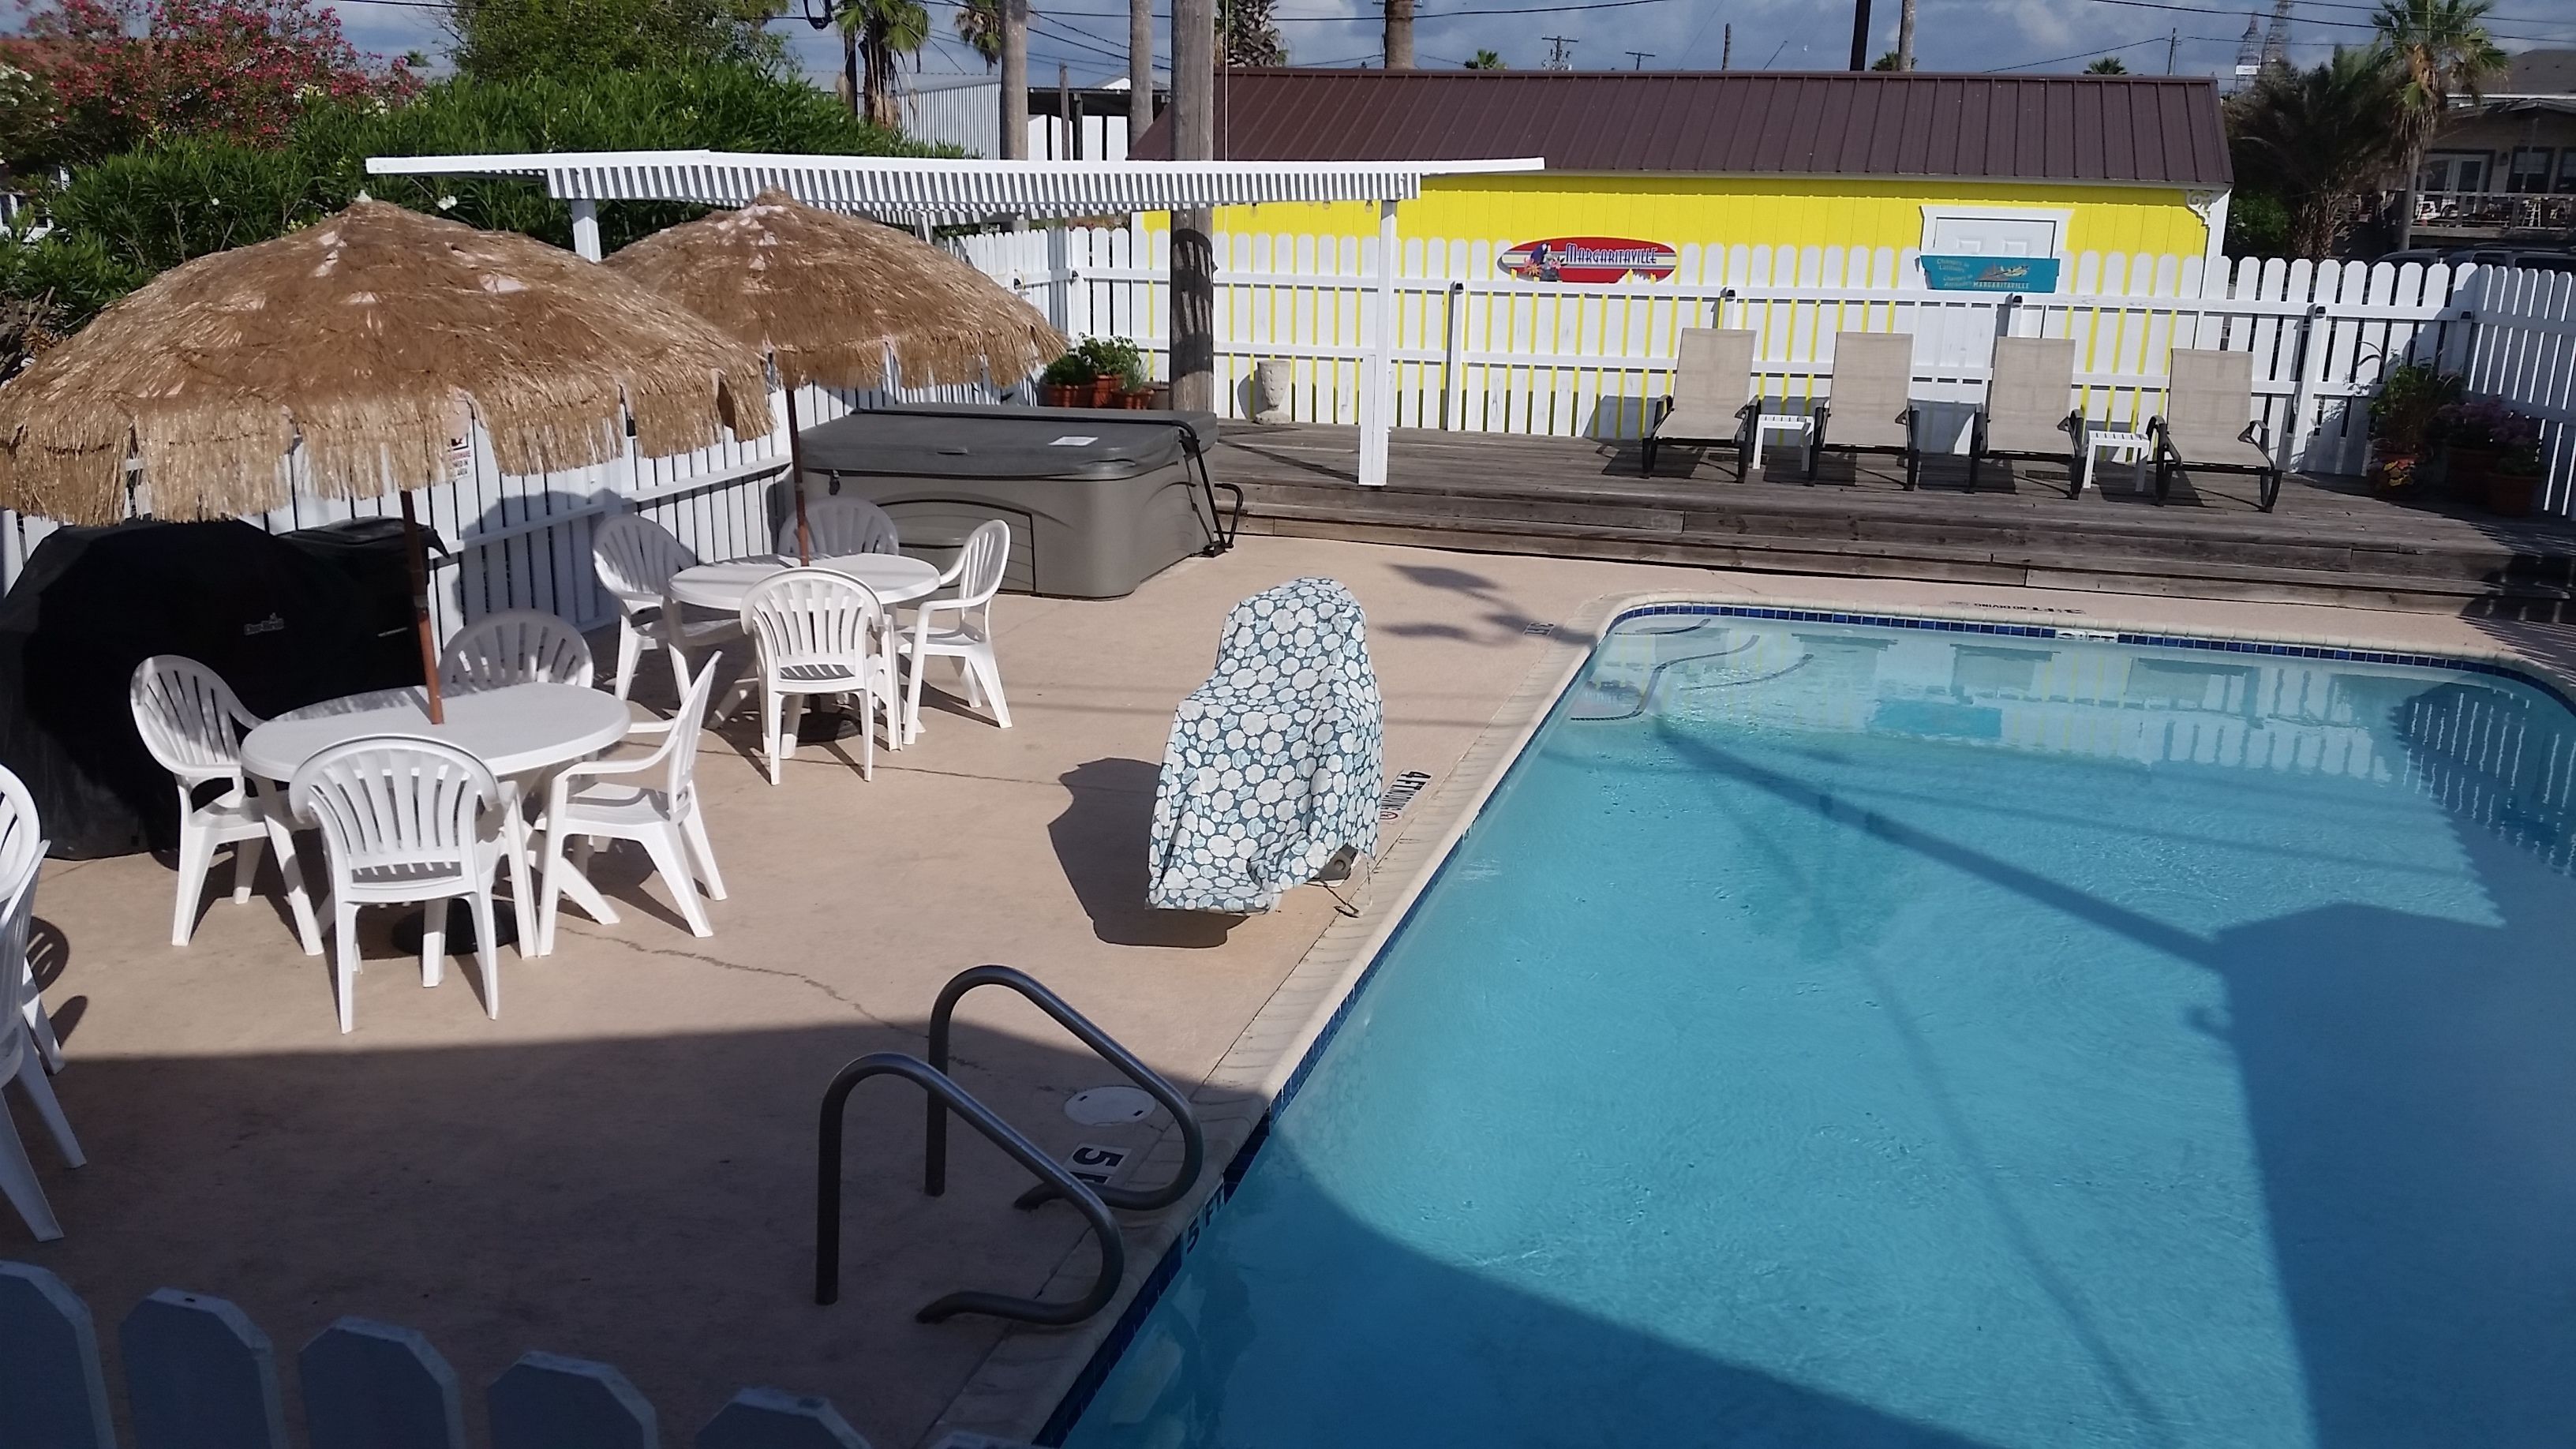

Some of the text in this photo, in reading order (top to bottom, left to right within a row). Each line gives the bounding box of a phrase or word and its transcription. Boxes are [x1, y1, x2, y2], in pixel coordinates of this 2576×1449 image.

[1566, 242, 1657, 264] MARGARITAVILLE
[1973, 281, 2030, 290] MARGARITAVILLE
[1391, 779, 1426, 791] FT
[1073, 1147, 1124, 1167] 5
[1186, 1215, 1200, 1255] 5
